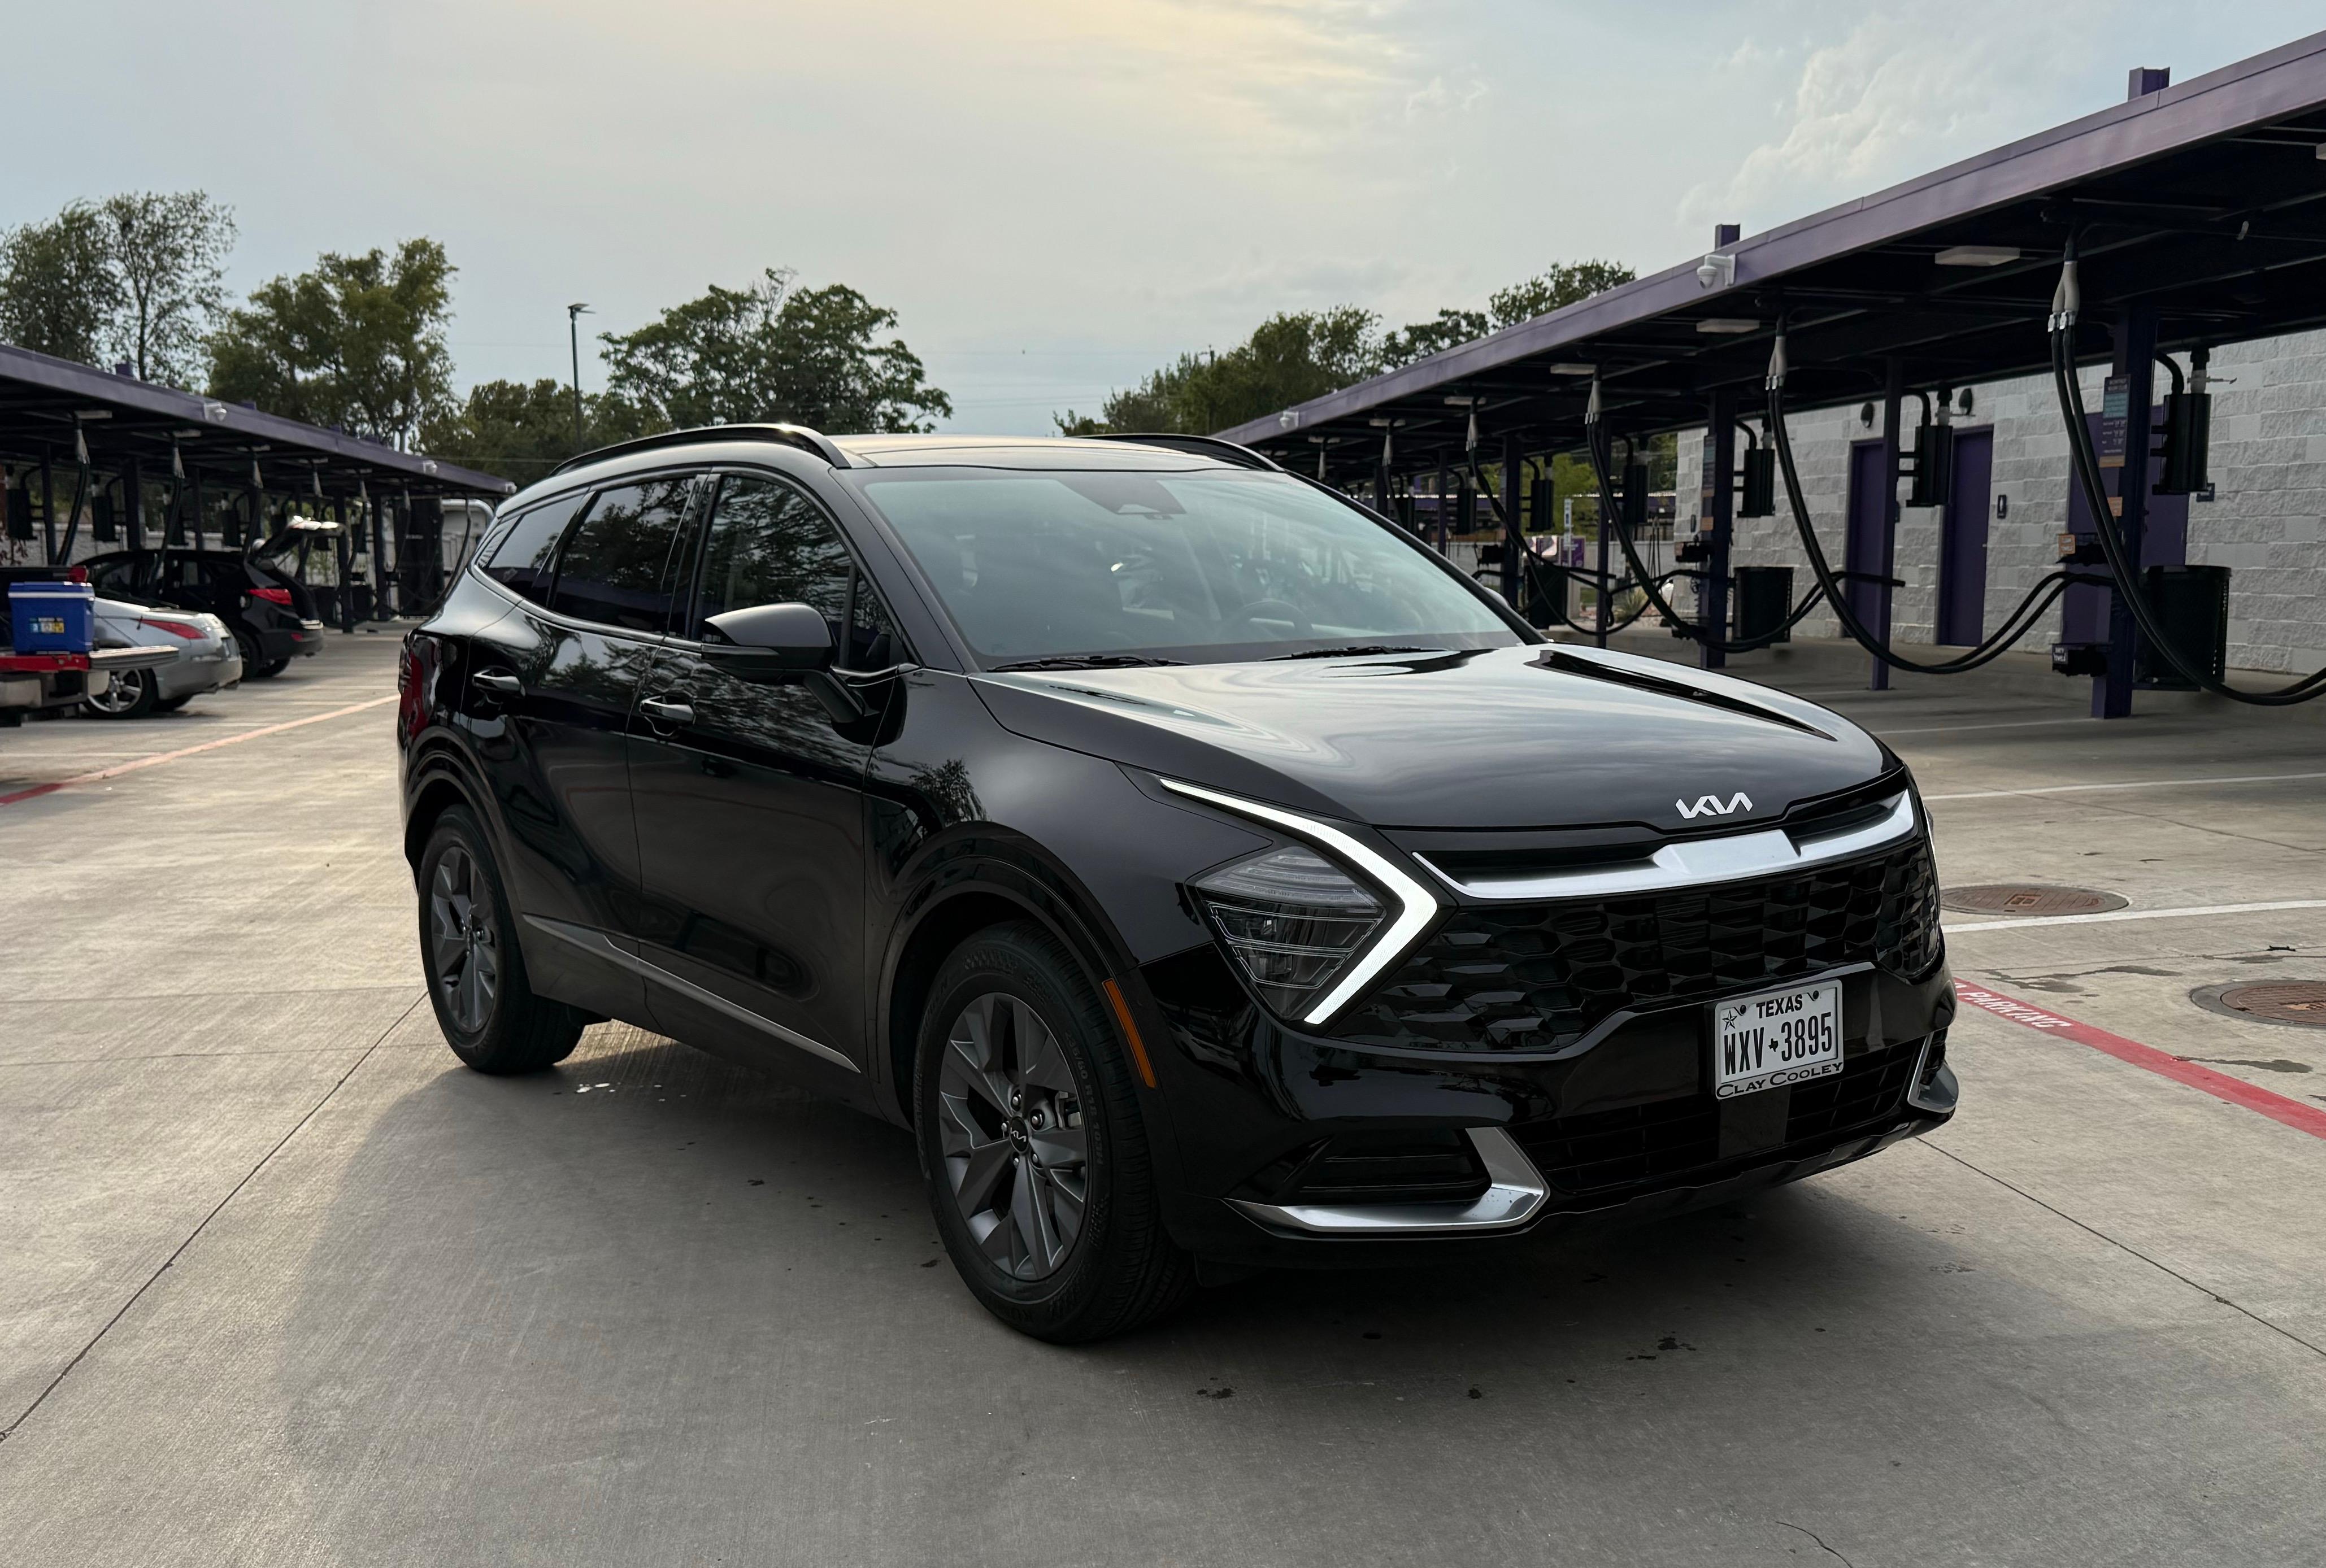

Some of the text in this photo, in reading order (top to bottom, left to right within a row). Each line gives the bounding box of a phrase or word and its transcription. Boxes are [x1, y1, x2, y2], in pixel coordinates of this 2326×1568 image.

[1676, 792, 1753, 819] KIA
[1756, 994, 1803, 1018] TEXAS
[1957, 992, 2073, 1027] PARKING
[1724, 1012, 1832, 1075] WXV 3895
[1716, 1062, 1844, 1098] CLAY COOLEY
